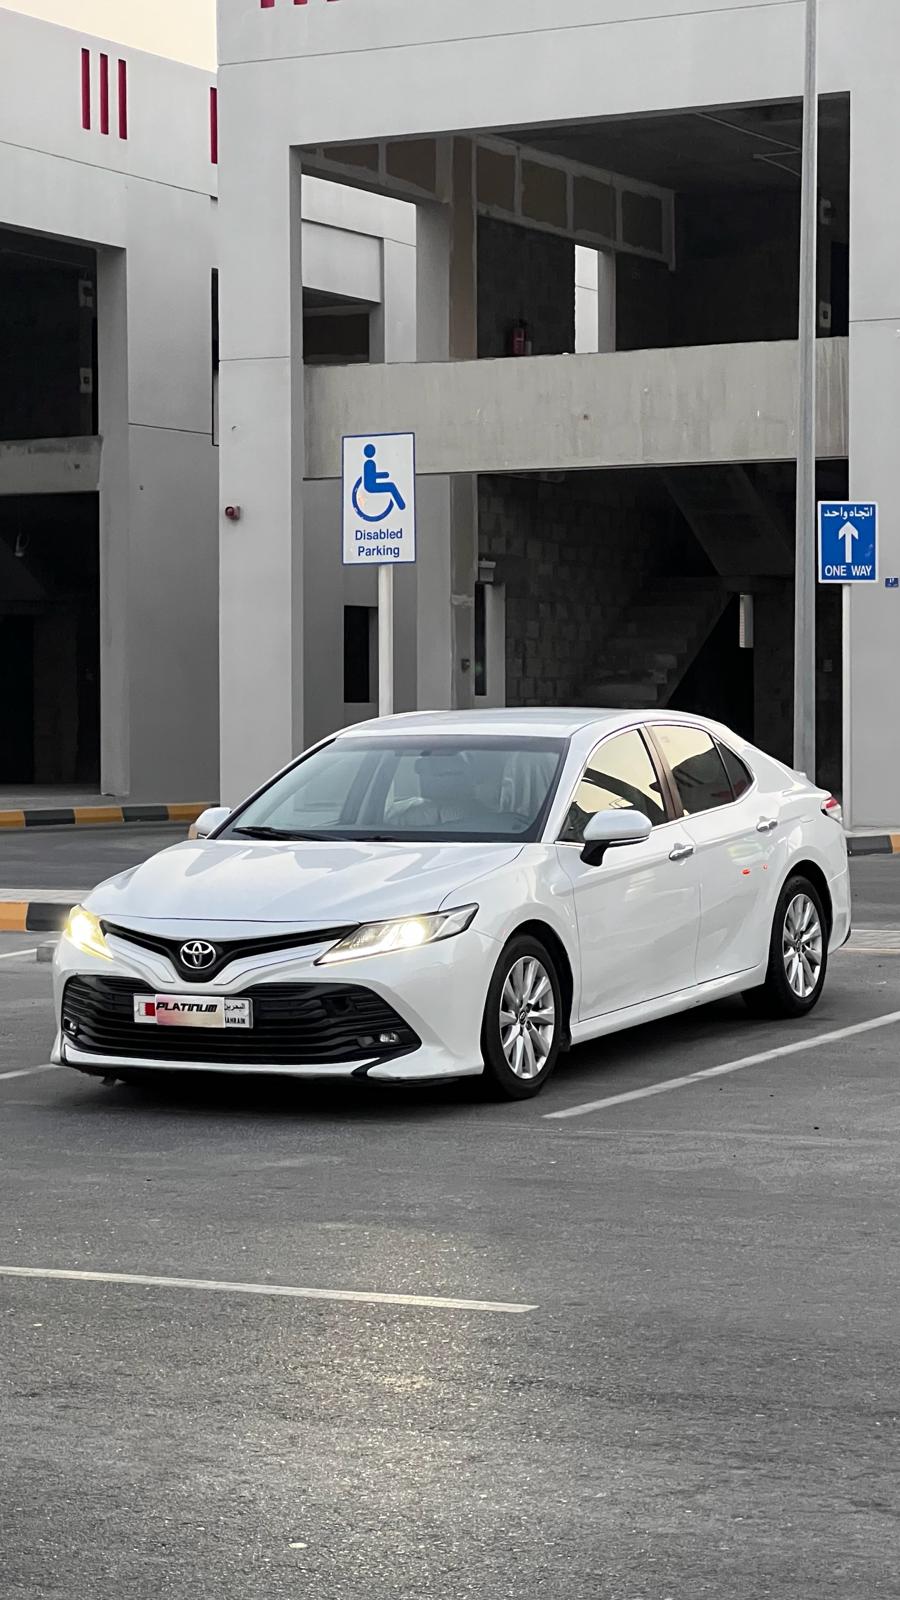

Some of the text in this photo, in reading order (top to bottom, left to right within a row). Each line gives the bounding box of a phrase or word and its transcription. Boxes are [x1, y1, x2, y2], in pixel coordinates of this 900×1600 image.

[824, 507, 872, 520] اتجاه واحد
[355, 528, 403, 541] Disabled
[357, 545, 400, 558] Parking
[824, 564, 872, 577] ONE WAY
